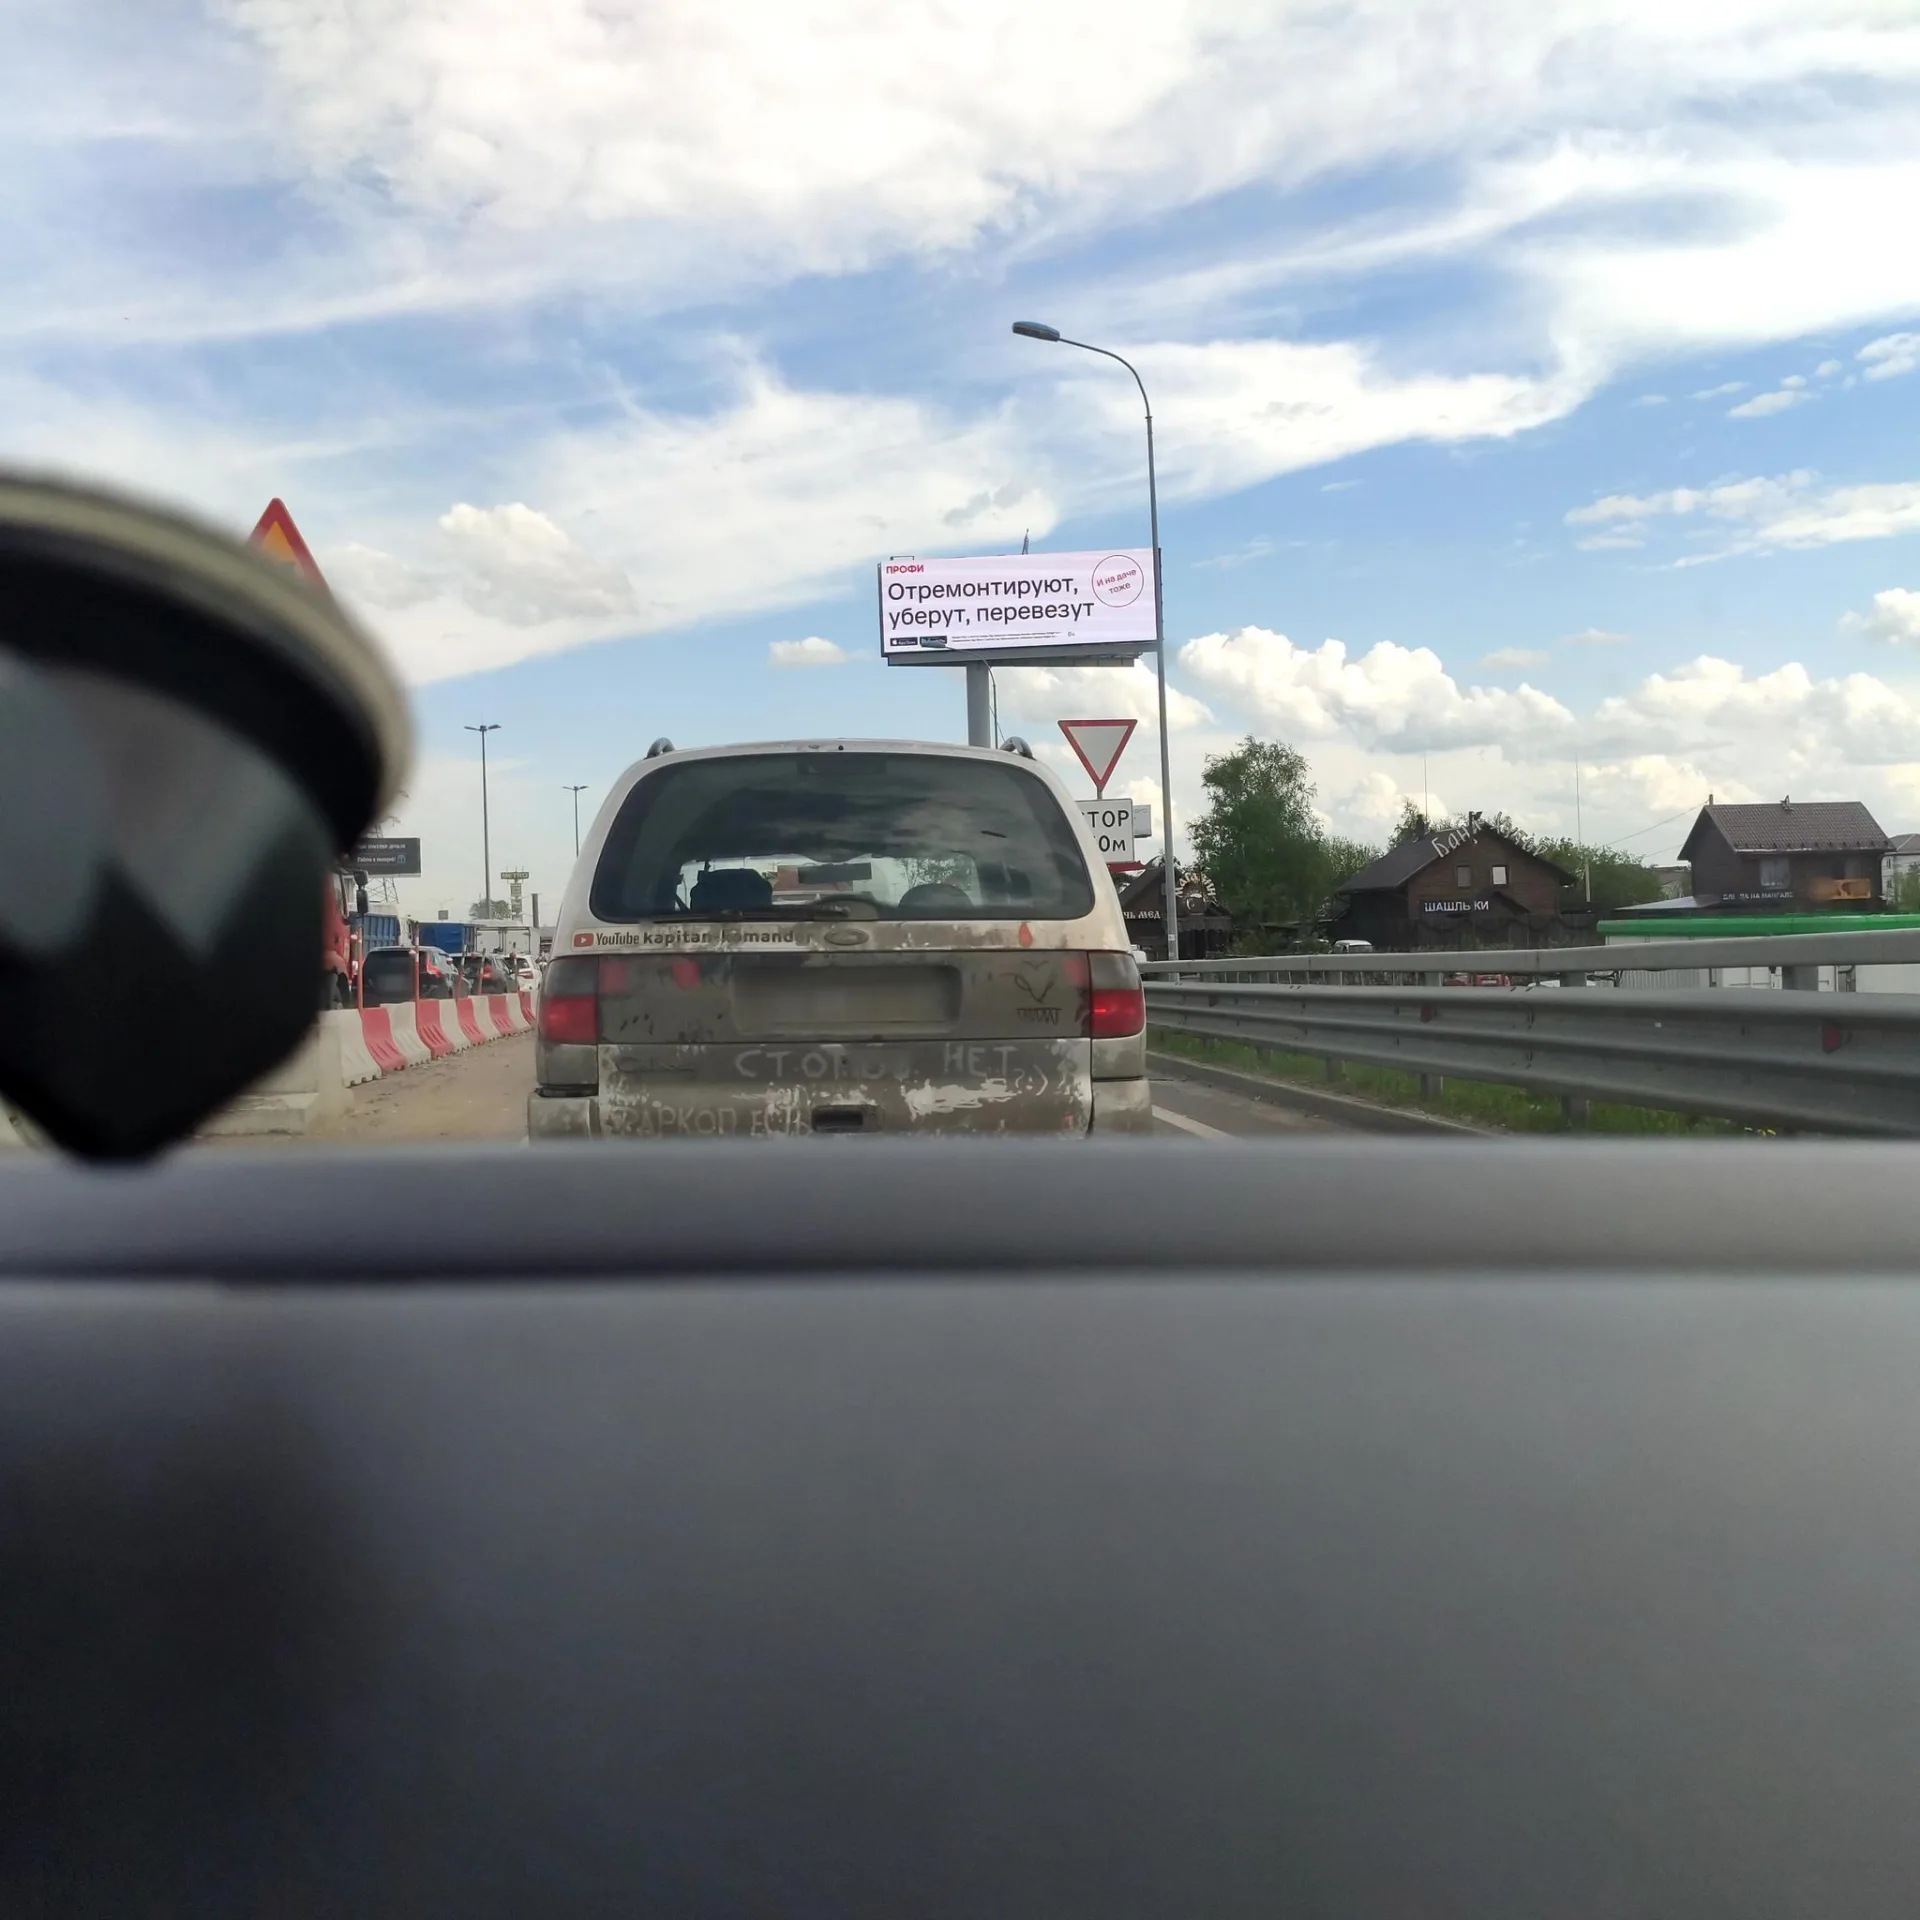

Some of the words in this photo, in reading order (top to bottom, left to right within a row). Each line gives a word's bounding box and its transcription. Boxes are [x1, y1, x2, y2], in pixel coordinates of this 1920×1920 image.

[886, 564, 925, 575] ПРОФИ
[1116, 569, 1137, 582] даче
[888, 577, 1079, 603] Отремонтируют,
[1108, 582, 1131, 595] тоже
[888, 607, 970, 631] уберут,
[976, 602, 1095, 625] перевезут
[1081, 809, 1129, 828] TOP
[1093, 834, 1126, 852] 0м
[596, 931, 640, 946] YouTube
